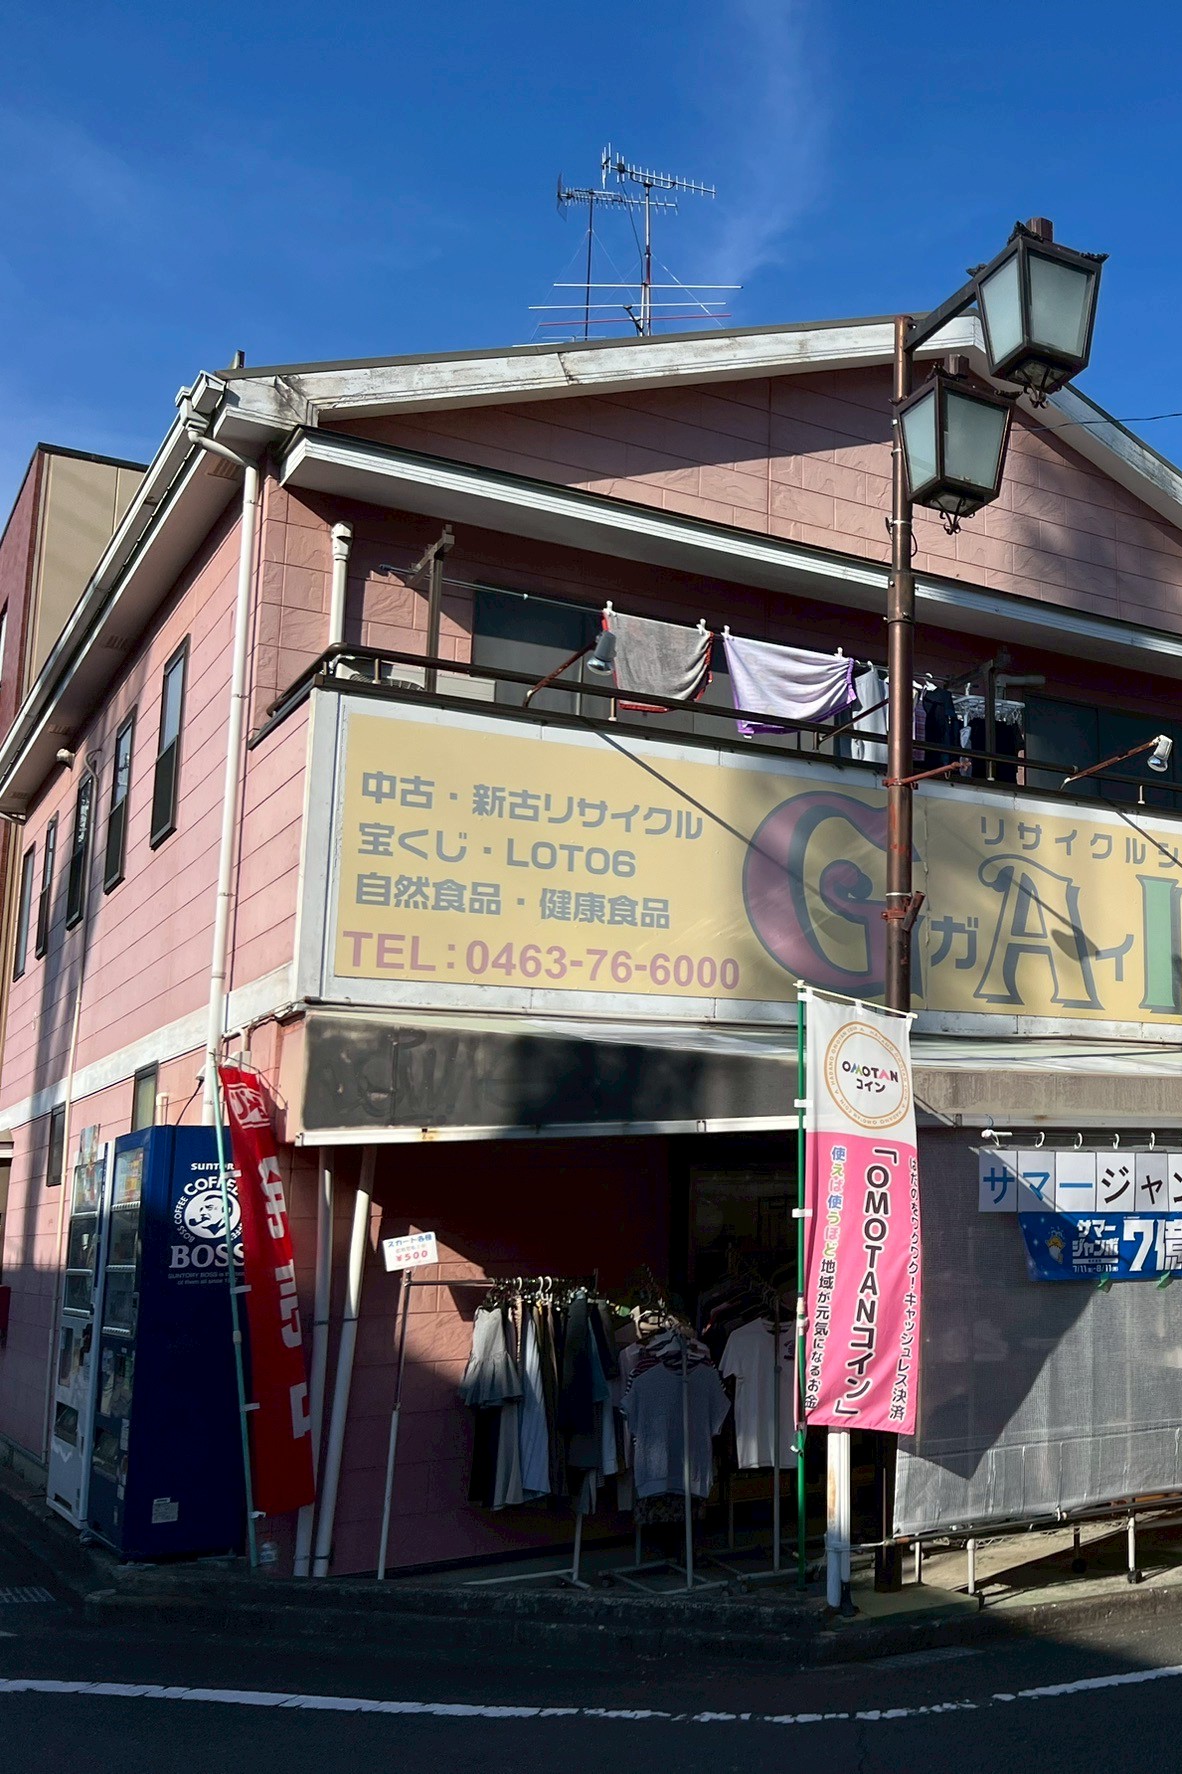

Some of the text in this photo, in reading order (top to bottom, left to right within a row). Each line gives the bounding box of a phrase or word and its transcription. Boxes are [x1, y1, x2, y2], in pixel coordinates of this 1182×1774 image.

[361, 771, 703, 840] 中古・新古リサイクル
[357, 822, 637, 878] 宝くじ・LOTO6
[355, 872, 670, 930] 自然食品・健康食品
[842, 1060, 899, 1083] OMOTAN
[856, 1078, 886, 1093] コイン
[1077, 1219, 1117, 1238] サマー
[168, 1243, 245, 1269] BOSS
[1072, 1238, 1119, 1257] ジャンボ
